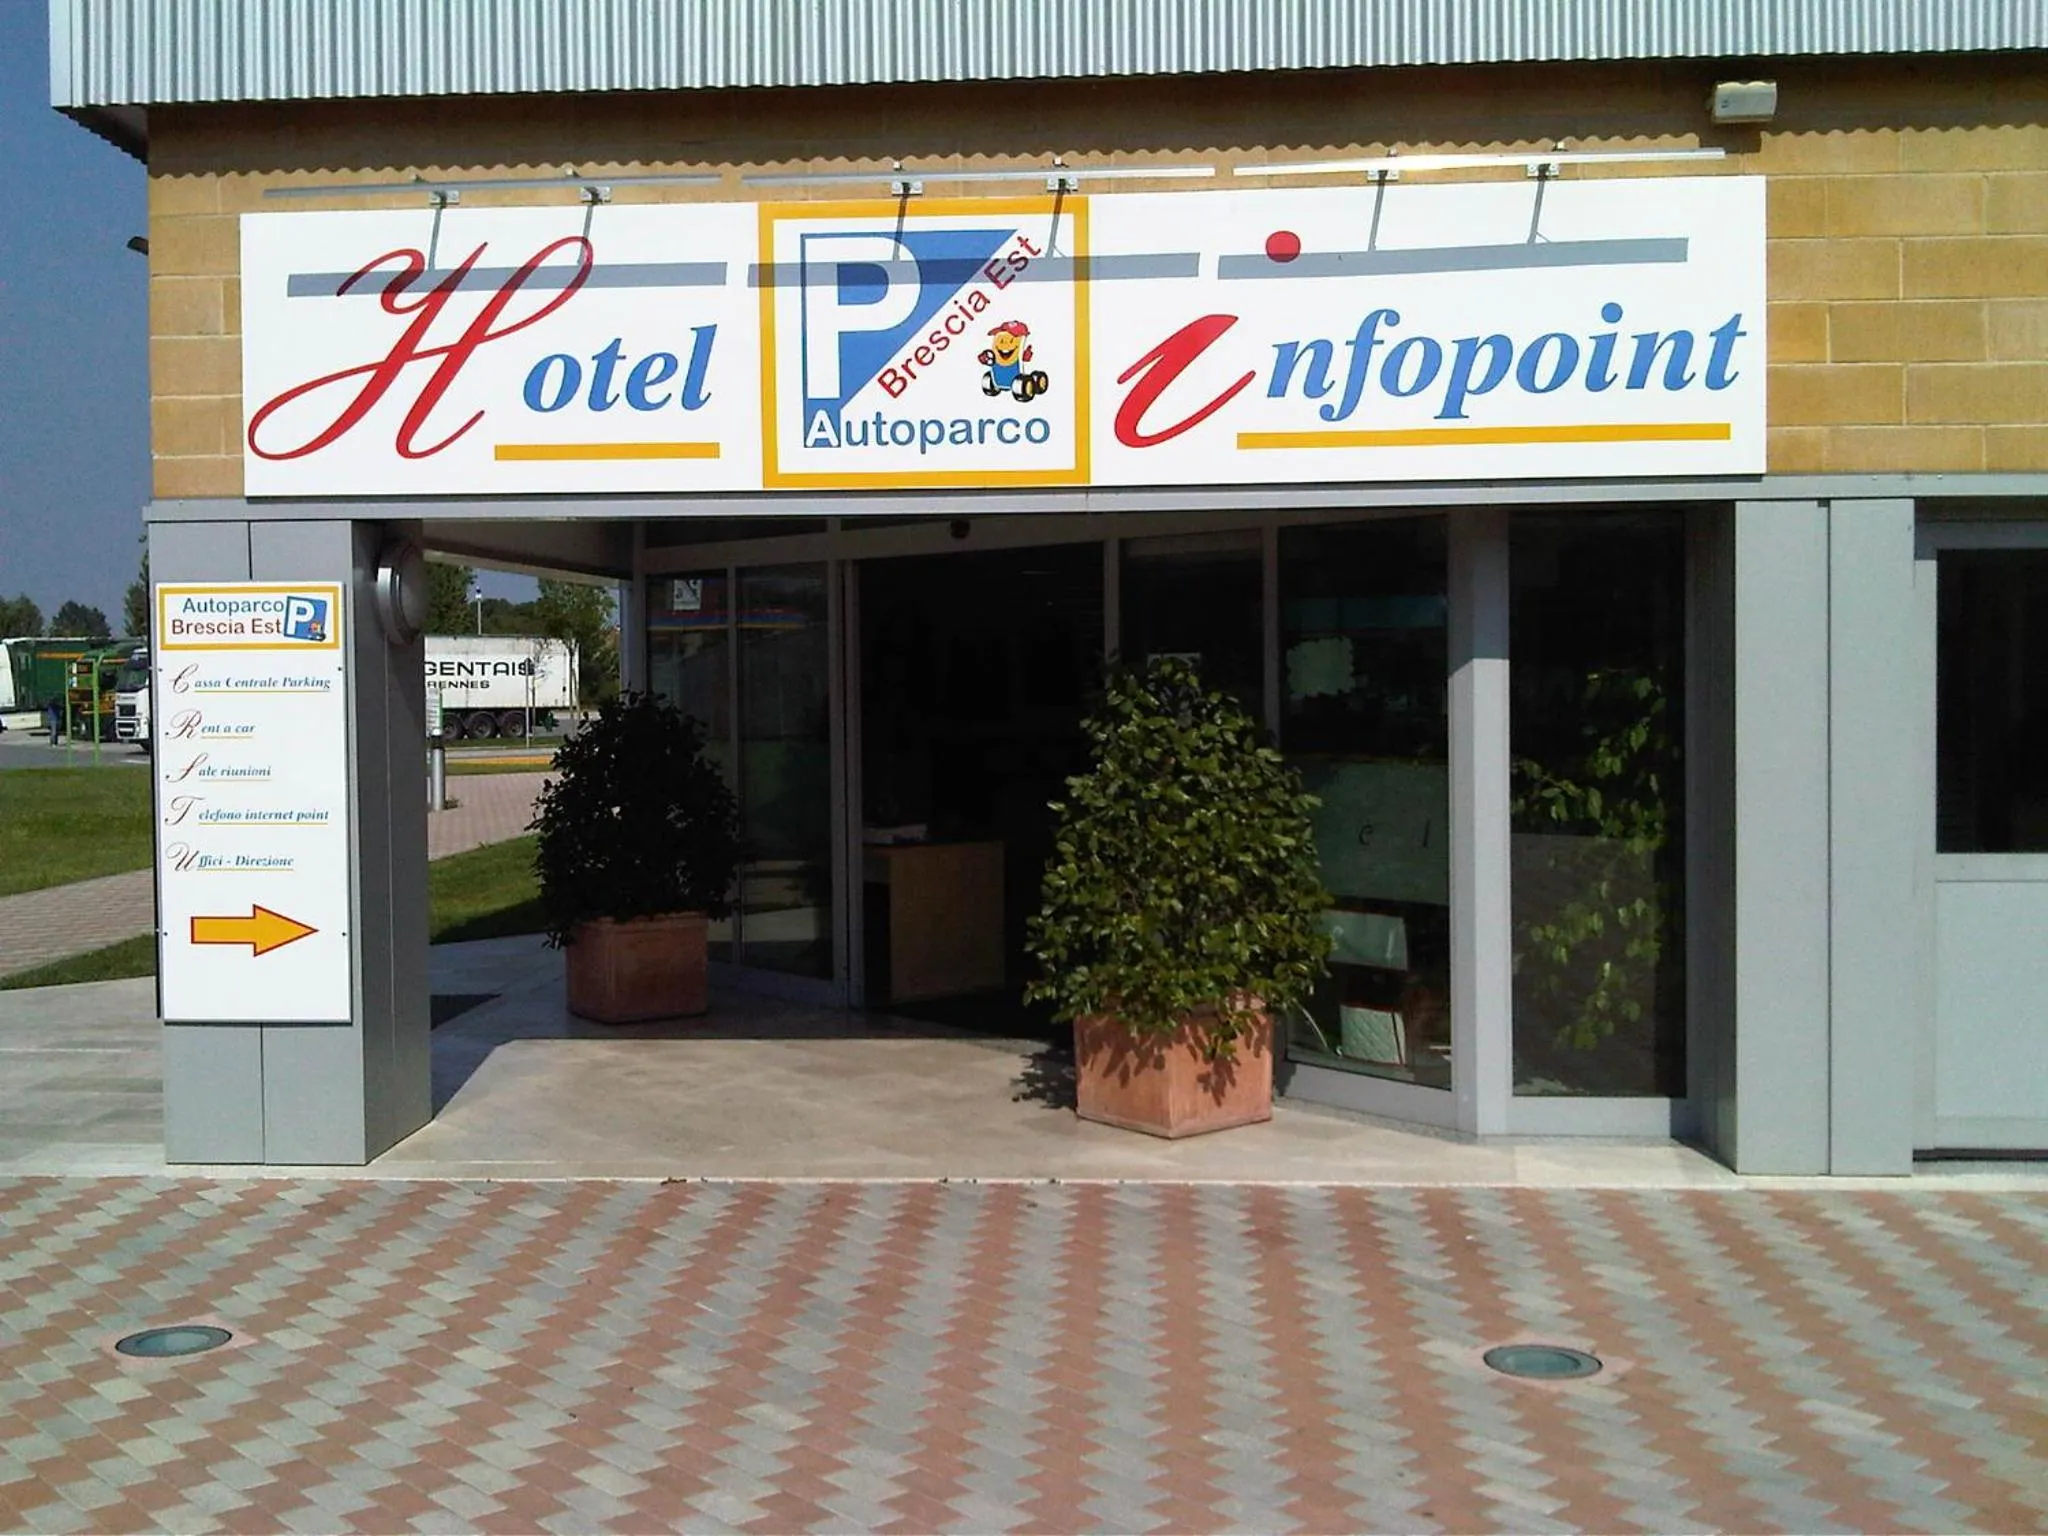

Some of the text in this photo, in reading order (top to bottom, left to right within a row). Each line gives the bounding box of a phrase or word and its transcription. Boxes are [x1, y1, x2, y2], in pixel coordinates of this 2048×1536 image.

[876, 234, 1044, 399] Brescia Est
[248, 236, 719, 461] Hotel
[1114, 230, 1748, 448] infopoint
[804, 409, 1051, 455] Autoparco
[182, 597, 285, 616] Autoparco
[171, 619, 282, 635] Brescia Est
[169, 663, 332, 694] Cassa Centrale Parking
[165, 709, 257, 739] Rent a car
[165, 752, 272, 783] Sale riunioni
[165, 795, 330, 826] Telefono internet point
[166, 841, 223, 872] Uffici
[235, 855, 294, 867] Direzione
